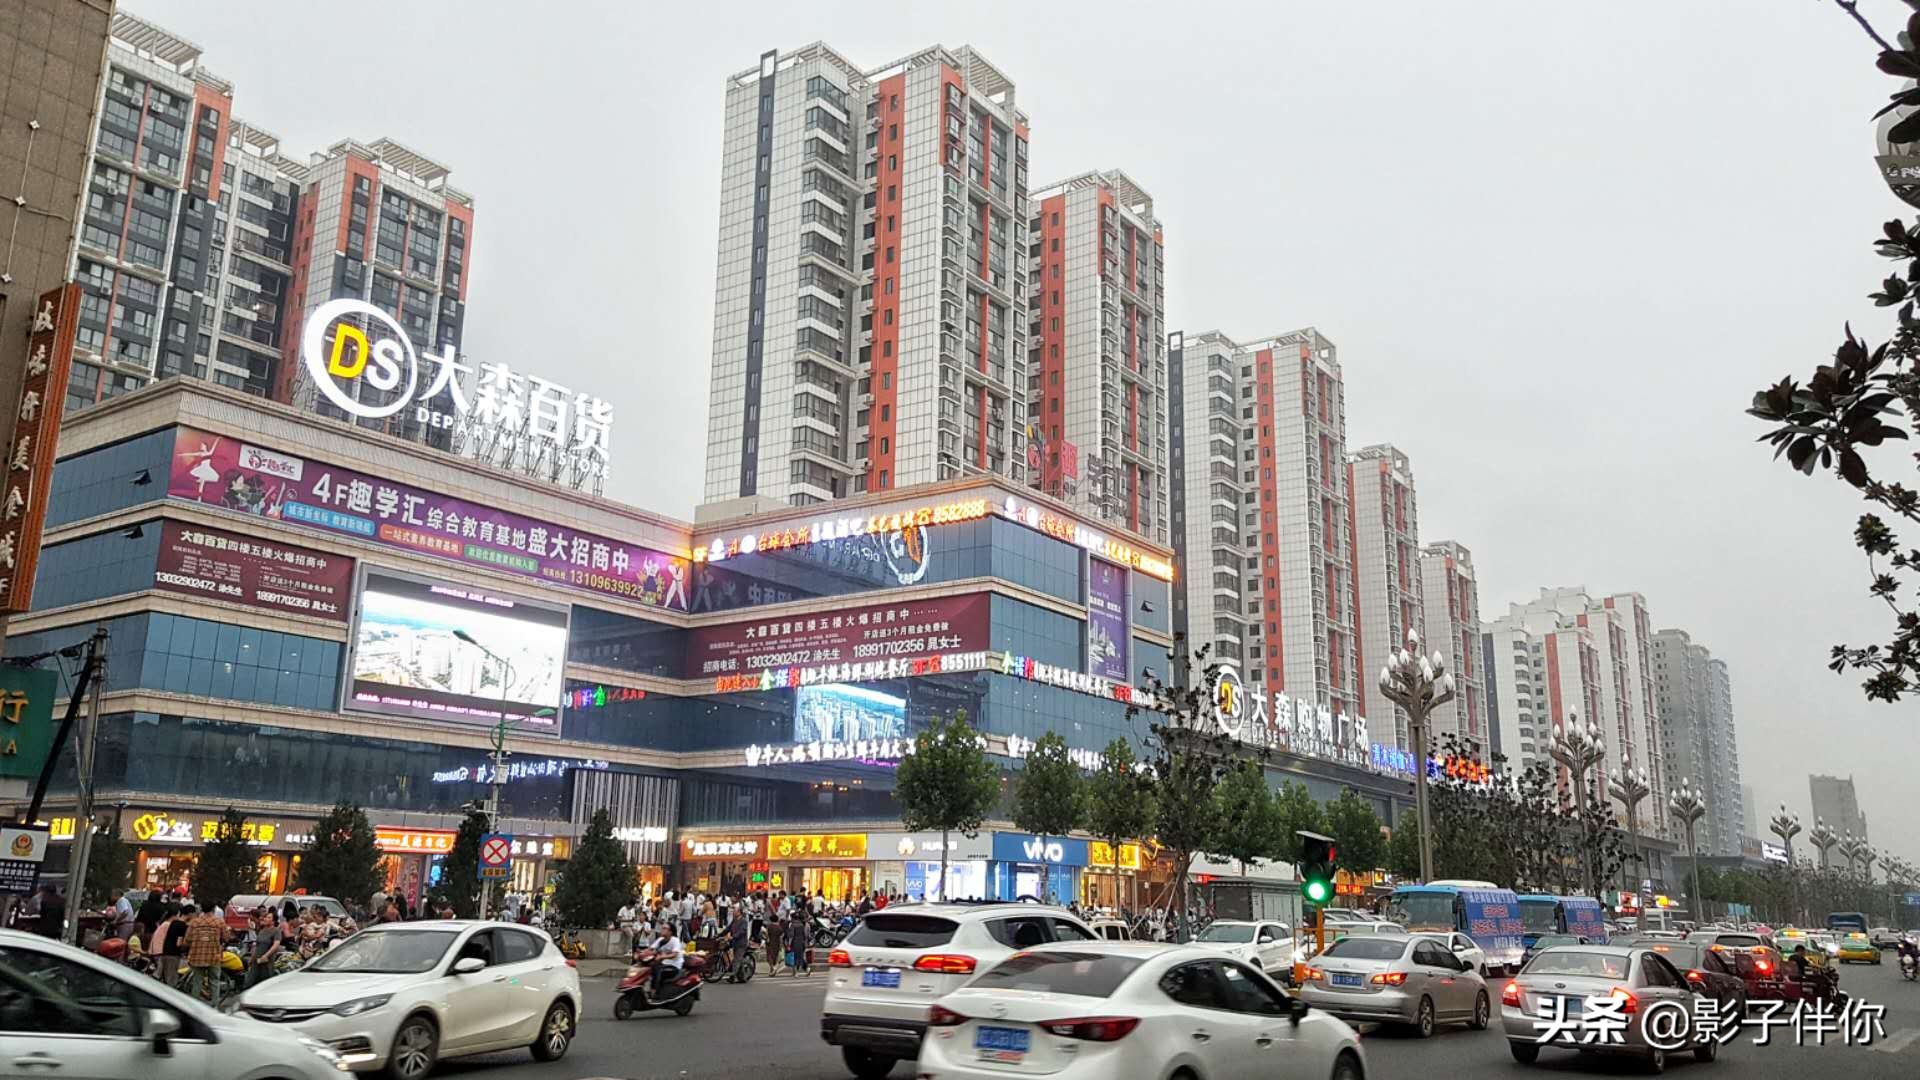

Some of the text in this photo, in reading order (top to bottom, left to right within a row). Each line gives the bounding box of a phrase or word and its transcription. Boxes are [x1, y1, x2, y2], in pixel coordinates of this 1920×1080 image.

[328, 322, 404, 391] DS
[417, 344, 614, 462] 大森百货
[415, 406, 610, 480] DEPARTMENT STORE
[745, 650, 811, 670] 13032902472
[853, 638, 925, 658] 18991702356
[940, 651, 987, 671] 8551111
[1251, 684, 1369, 751] 大森购物广场
